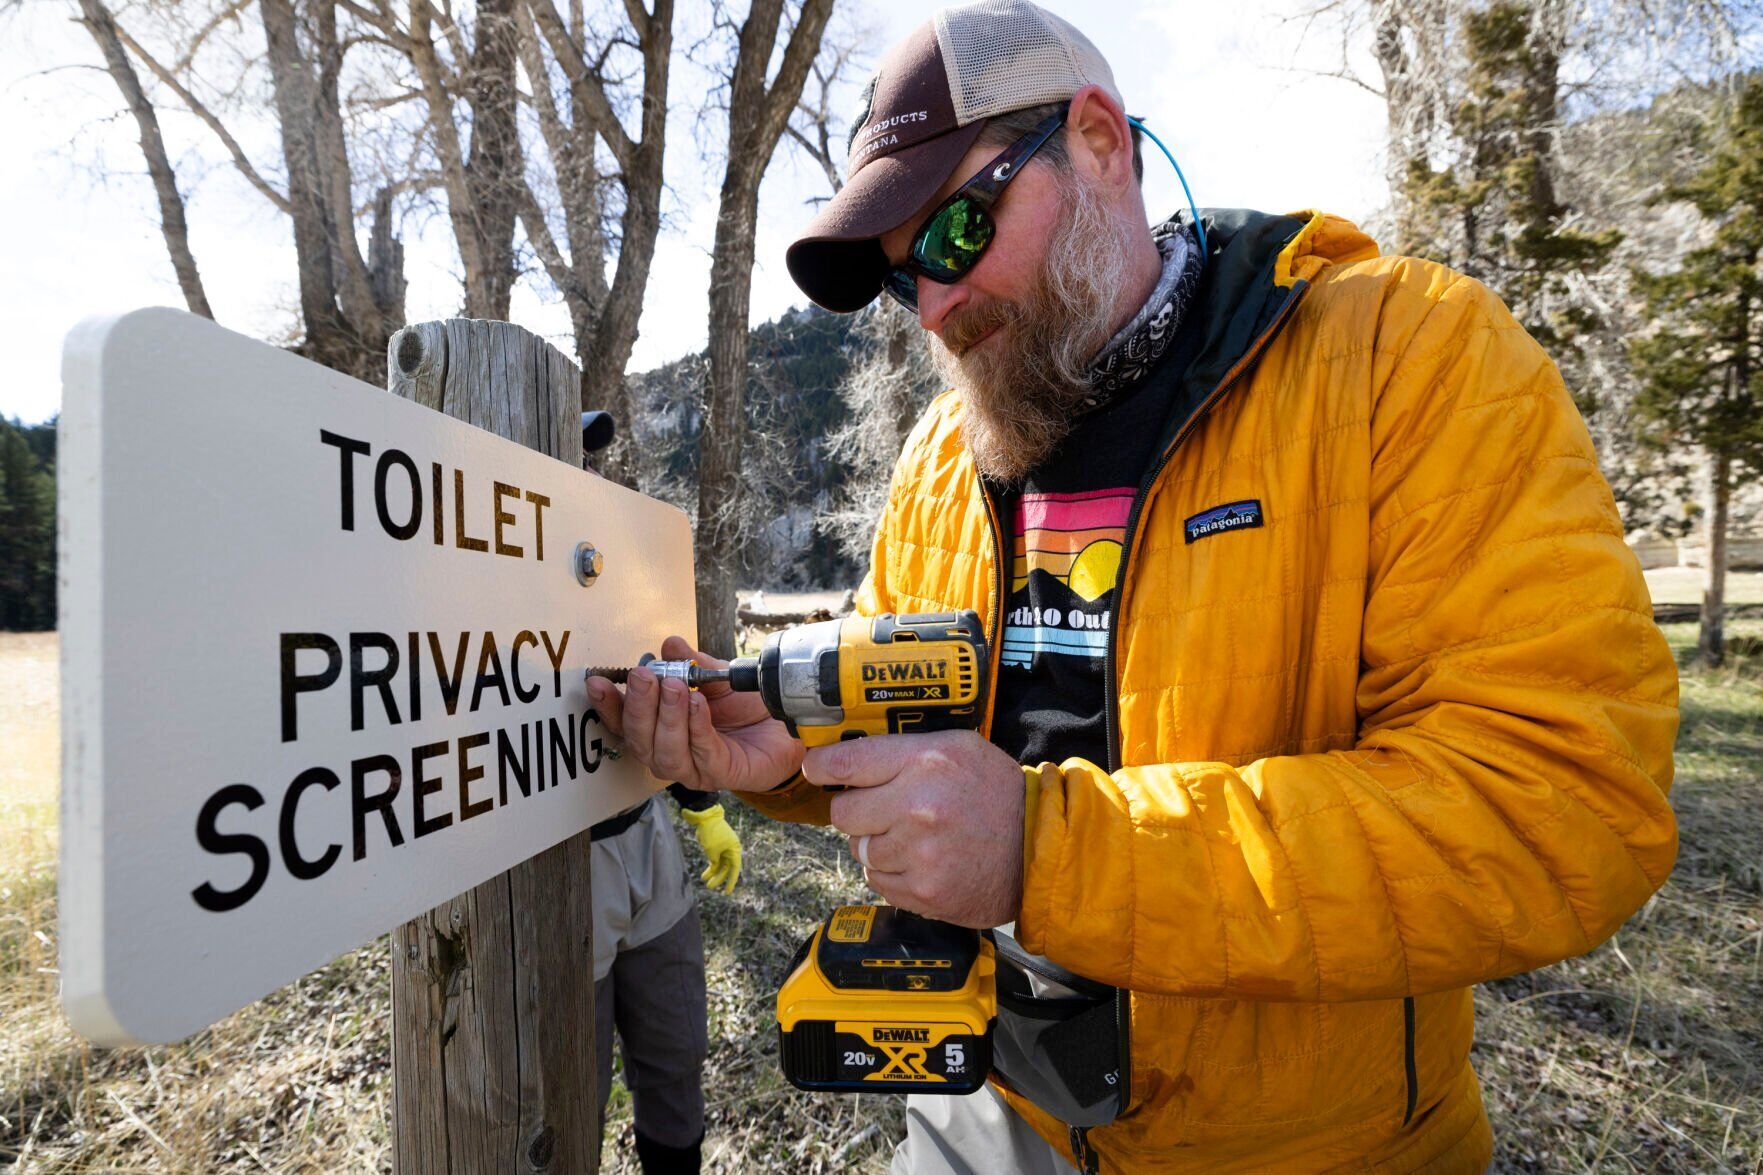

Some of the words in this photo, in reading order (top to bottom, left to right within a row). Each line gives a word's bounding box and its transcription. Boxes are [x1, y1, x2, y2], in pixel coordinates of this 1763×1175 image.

[319, 428, 551, 562] TOILET
[1192, 514, 1253, 538] patagonia
[279, 629, 571, 744] PRIVACY
[923, 687, 942, 698] XR
[190, 708, 603, 914] SCREENING
[873, 1028, 929, 1042] DEWALT
[880, 1047, 928, 1074] XR
[945, 1043, 965, 1067] 5
